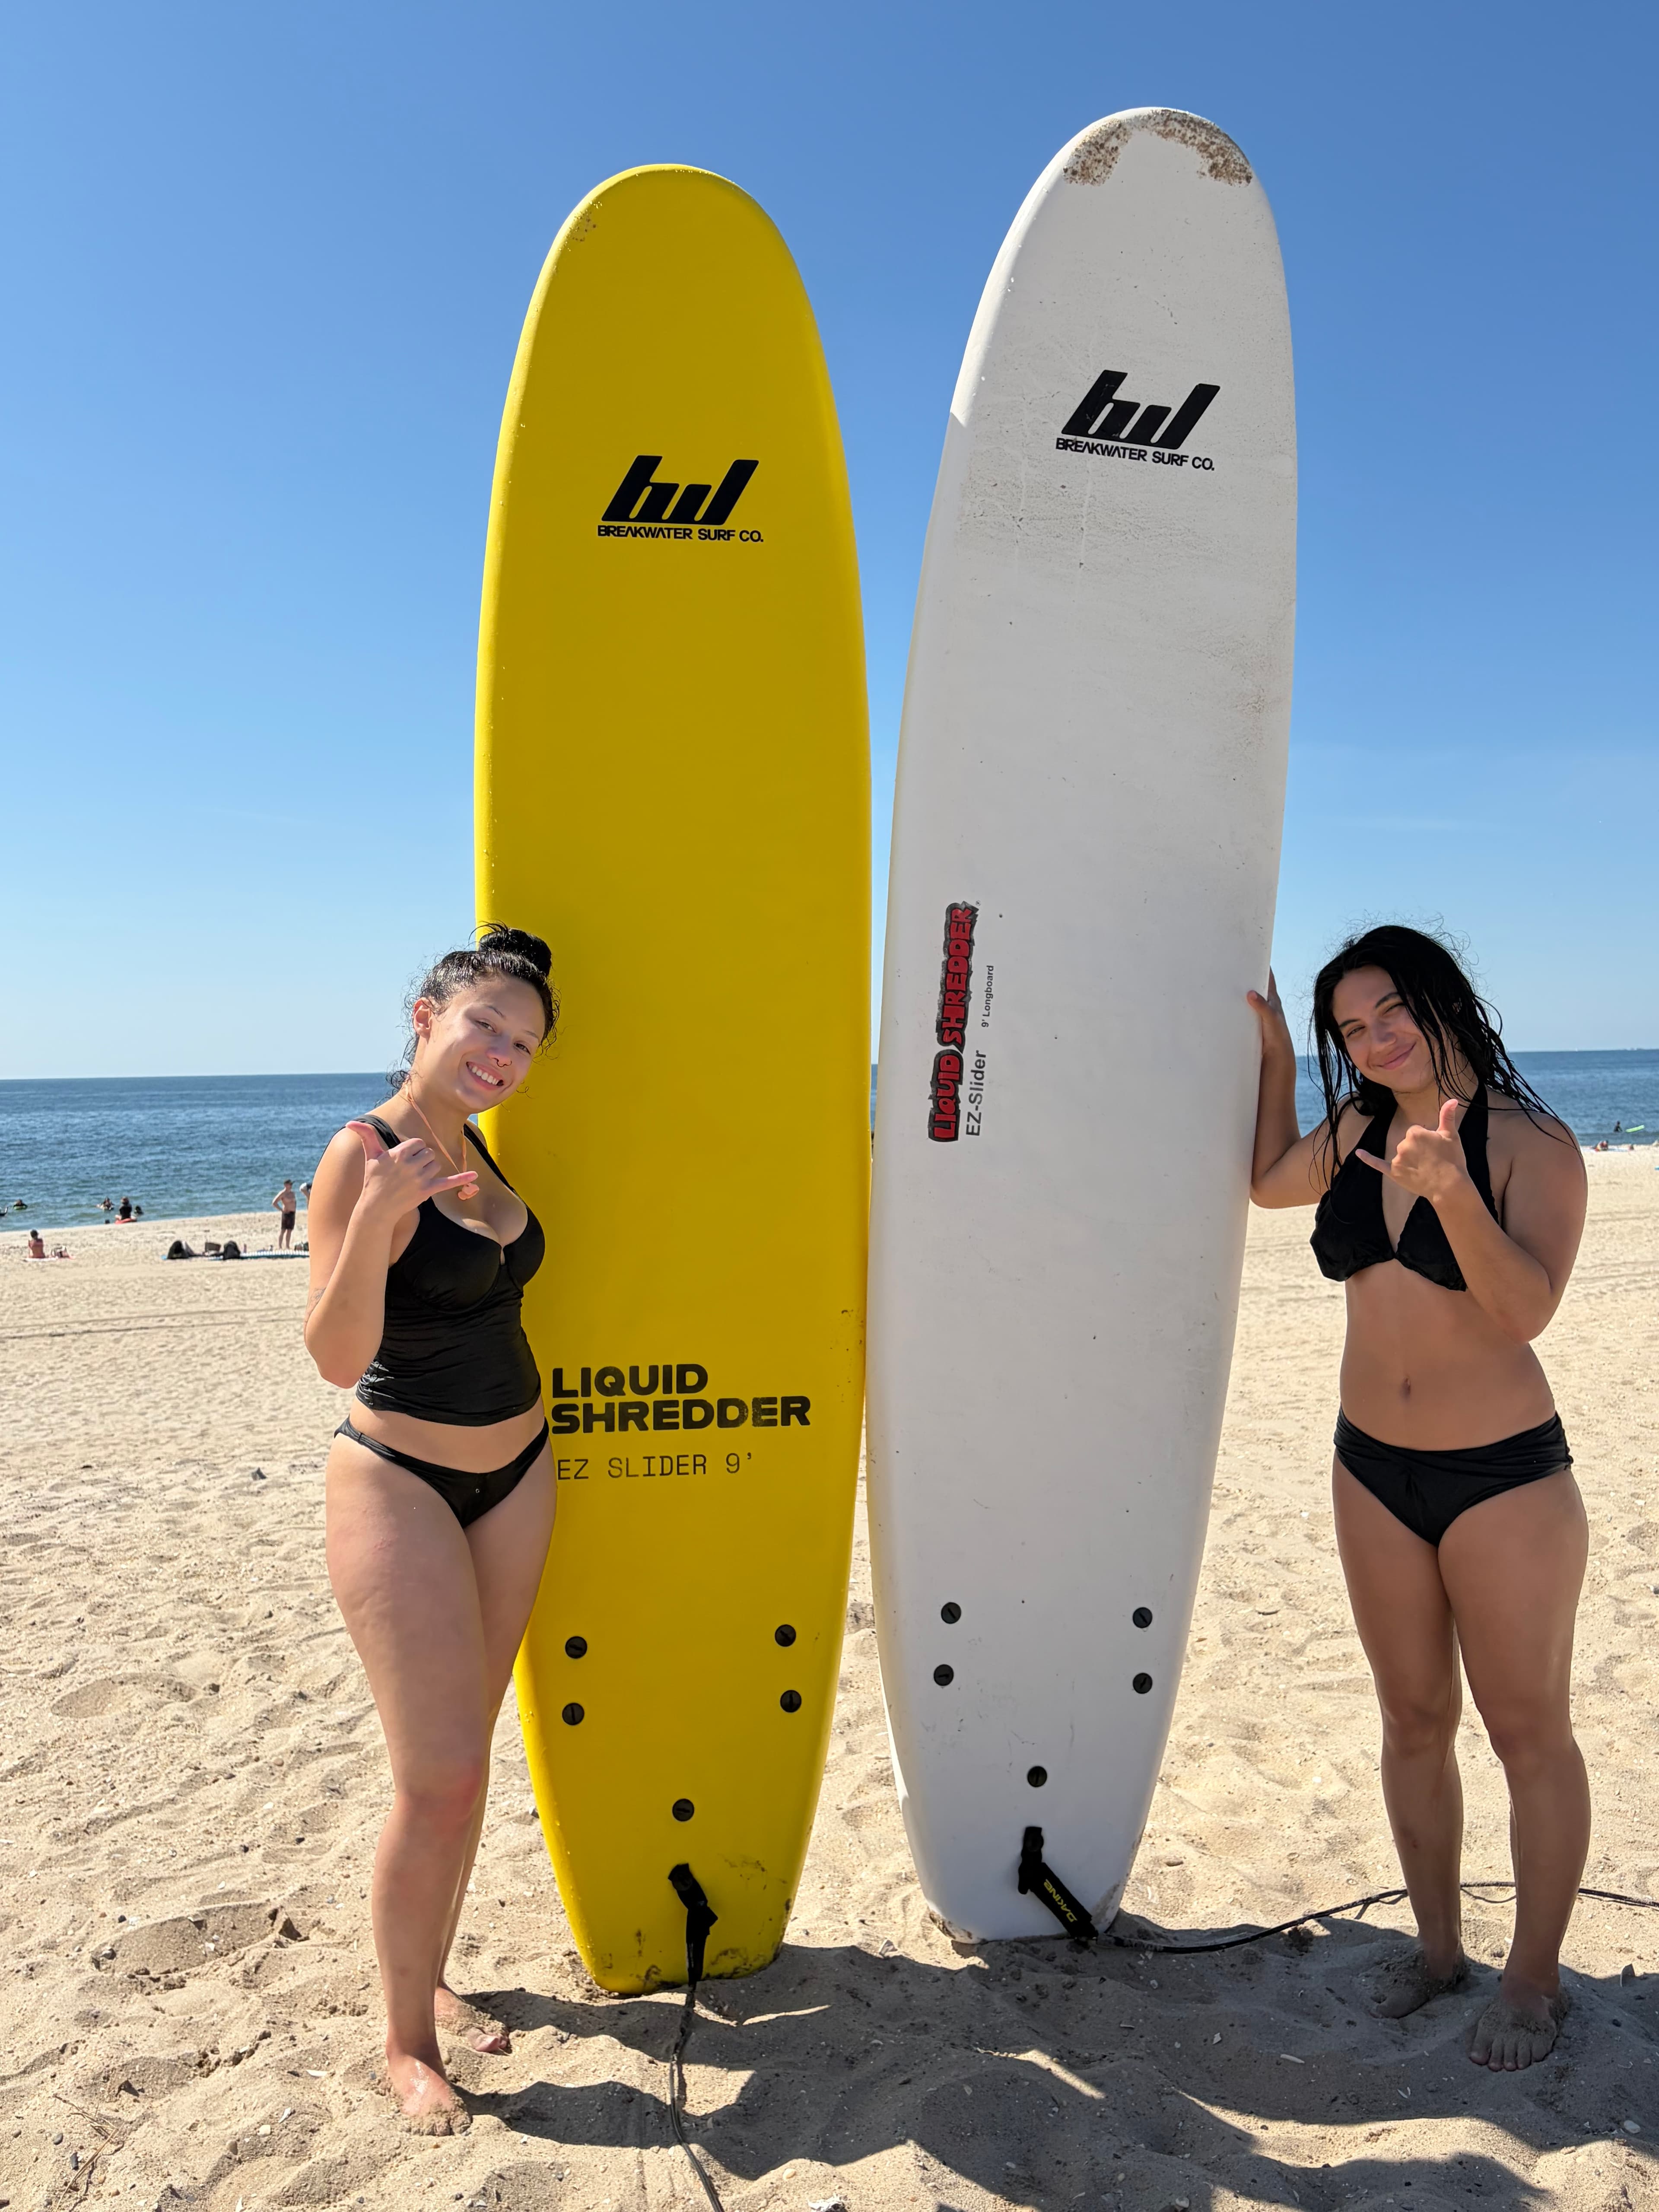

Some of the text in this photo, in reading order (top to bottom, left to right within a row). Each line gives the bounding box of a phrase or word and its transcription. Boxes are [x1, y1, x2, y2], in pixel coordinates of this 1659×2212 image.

[1055, 437, 1215, 471] BREAKWATER SURF CO.
[597, 525, 764, 542] BREAKWATER SURF CO.
[981, 965, 994, 1027] 9' Longboard
[933, 908, 972, 1139] LIQUID SHREDDER
[966, 1050, 986, 1136] EZ-Slider
[552, 1363, 708, 1398] LIQUID
[551, 1396, 810, 1434] SHREDDER
[558, 1452, 752, 1480] EZ SLIDER 9'
